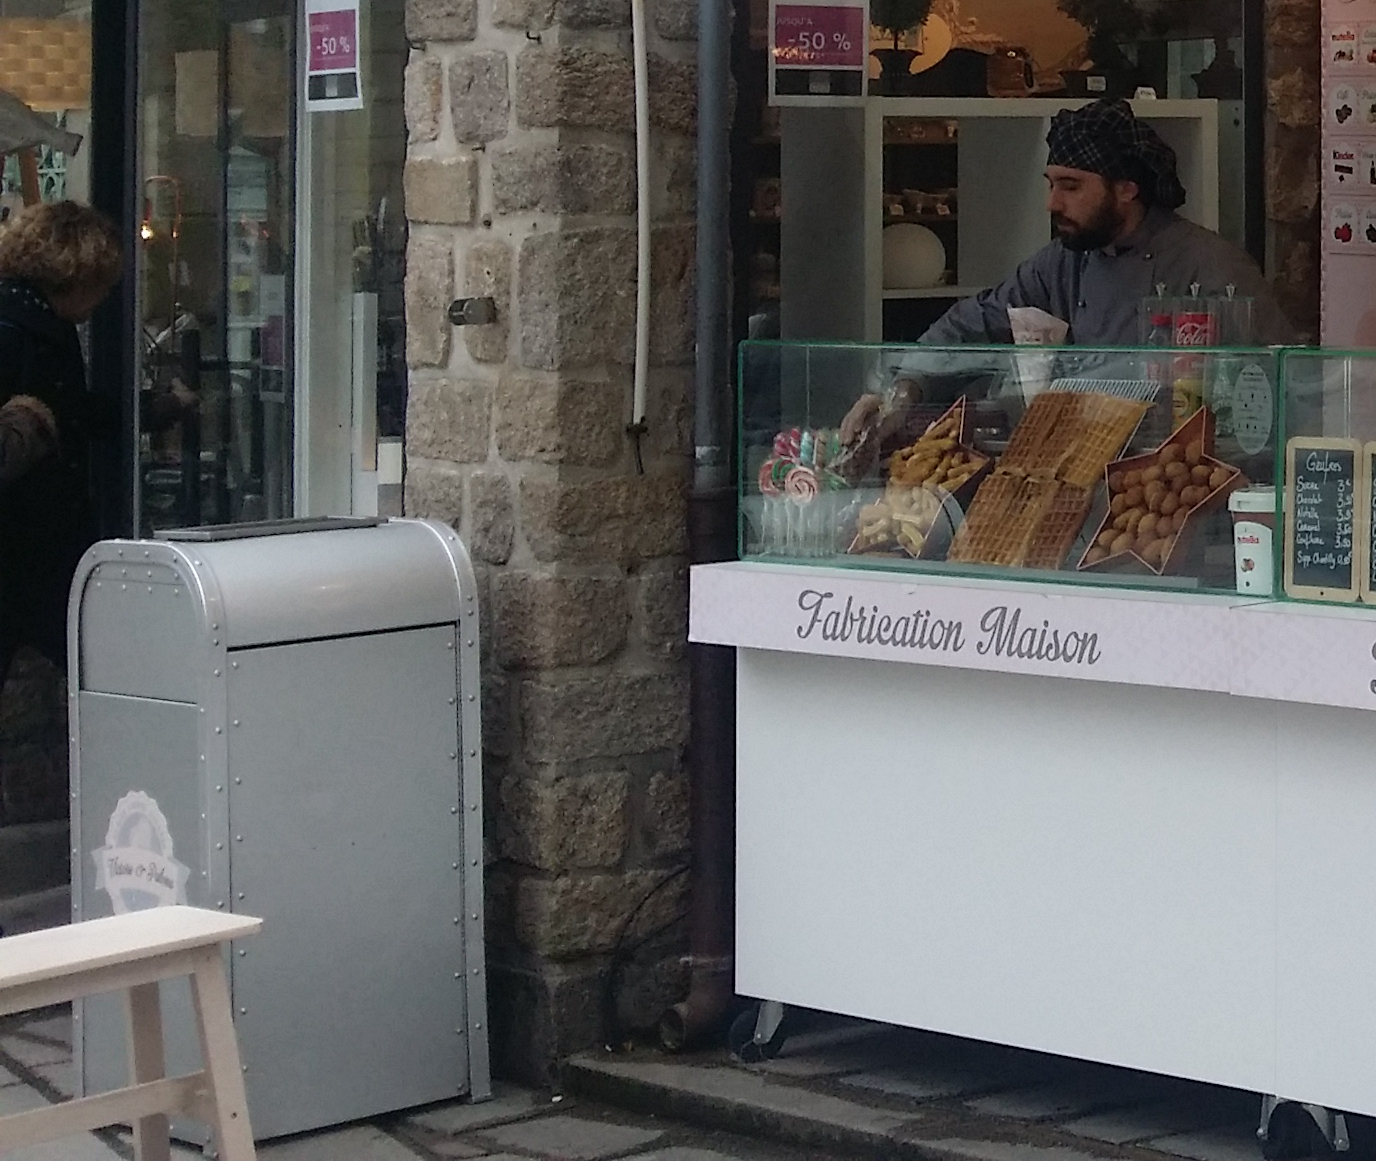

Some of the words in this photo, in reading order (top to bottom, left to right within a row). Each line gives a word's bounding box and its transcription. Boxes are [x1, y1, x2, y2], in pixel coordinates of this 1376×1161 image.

[316, 37, 336, 56] -50
[339, 36, 351, 53] %
[787, 31, 826, 51] -50
[832, 32, 852, 52] %
[796, 589, 965, 652] Fabrication
[976, 606, 1101, 666] Maison
